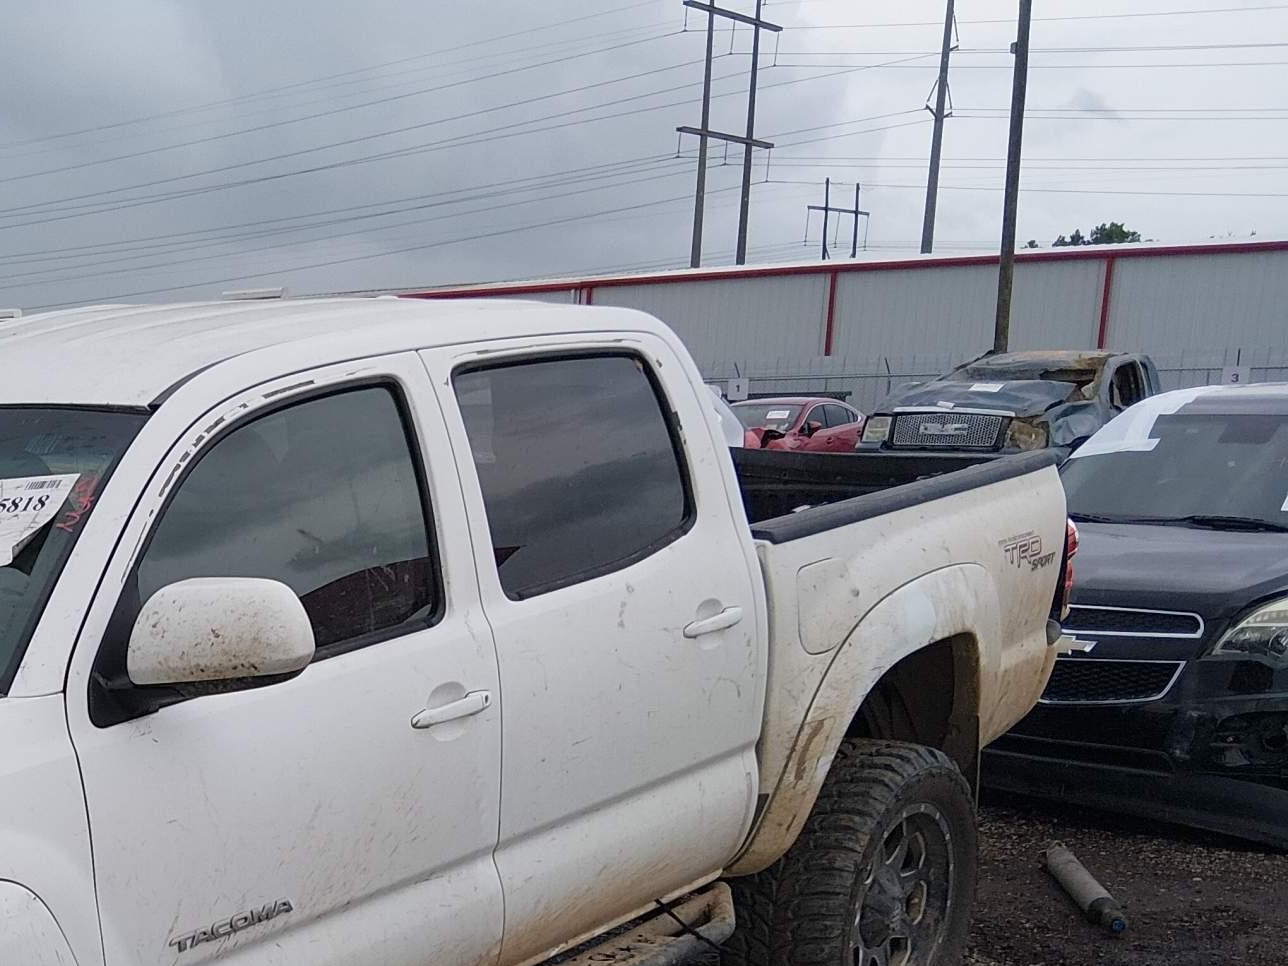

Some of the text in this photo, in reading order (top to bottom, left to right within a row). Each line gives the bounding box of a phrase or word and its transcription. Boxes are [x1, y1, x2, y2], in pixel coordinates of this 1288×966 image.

[1231, 373, 1240, 383] 3
[1003, 535, 1042, 569] TRD
[1031, 551, 1057, 573] SPORT
[168, 899, 294, 953] TACOMA
